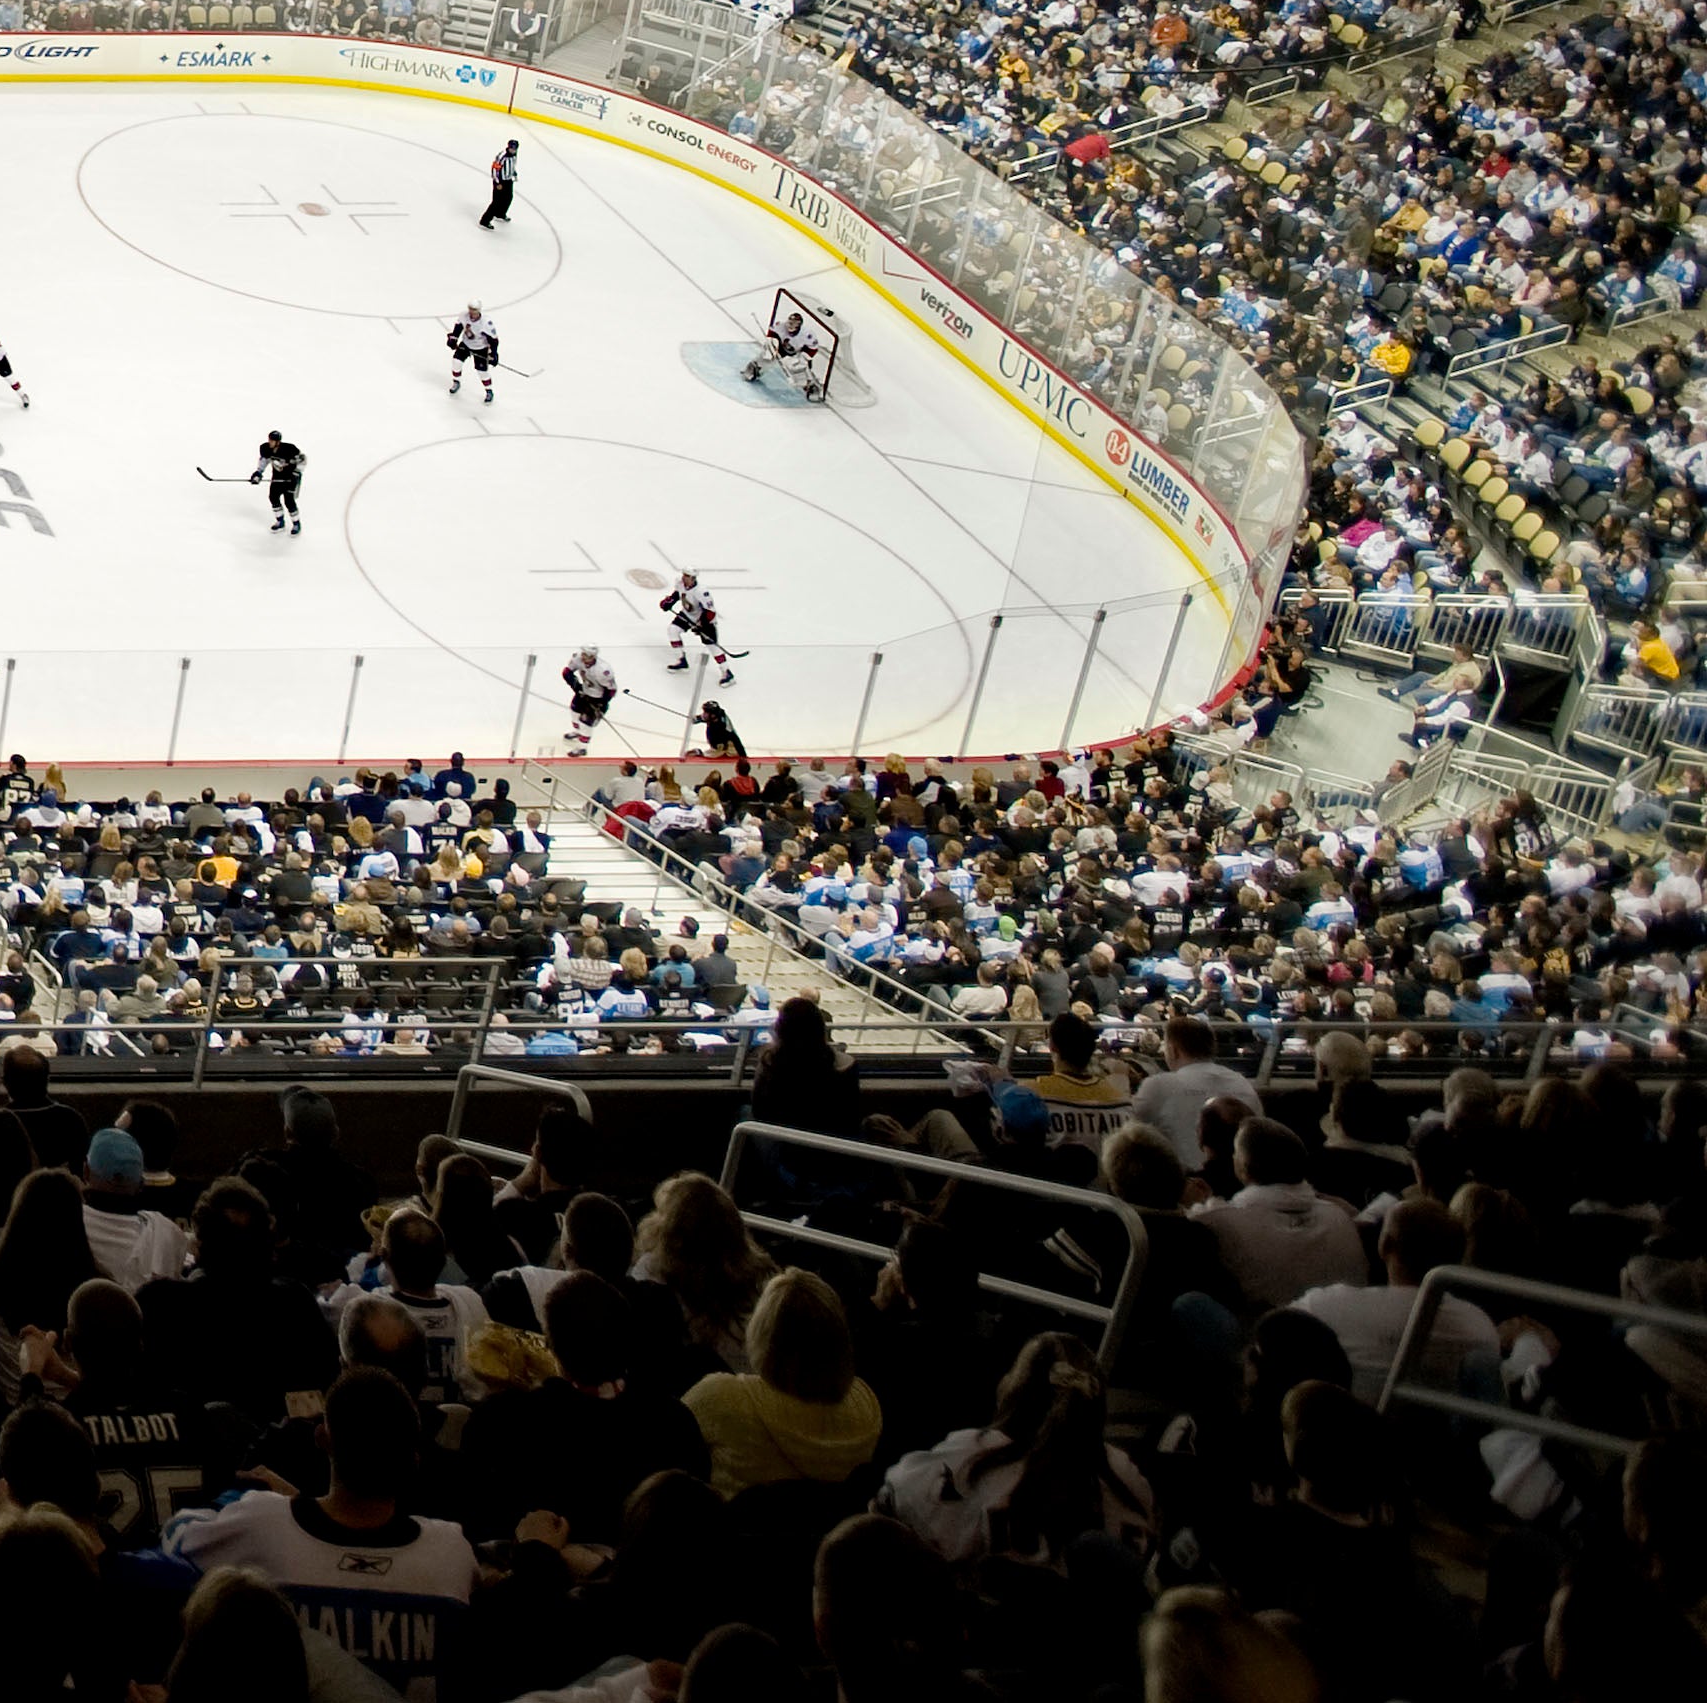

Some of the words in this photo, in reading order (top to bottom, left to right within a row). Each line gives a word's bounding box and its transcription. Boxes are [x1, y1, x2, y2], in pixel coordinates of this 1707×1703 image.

[23, 45, 100, 59] LIGHT
[176, 50, 257, 68] ESMARK
[348, 50, 455, 83] HIGHMARK
[549, 95, 584, 111] CANCER
[646, 119, 705, 152] CONSOL
[706, 143, 759, 175] ENERGY
[770, 163, 831, 232] TRIB
[836, 205, 870, 245] TOTAL
[834, 226, 868, 265] MEDIA
[919, 287, 975, 341] verizon
[996, 338, 1096, 440] UPMC
[1131, 450, 1190, 515] LUMBER
[84, 1410, 181, 1446] TALBOT
